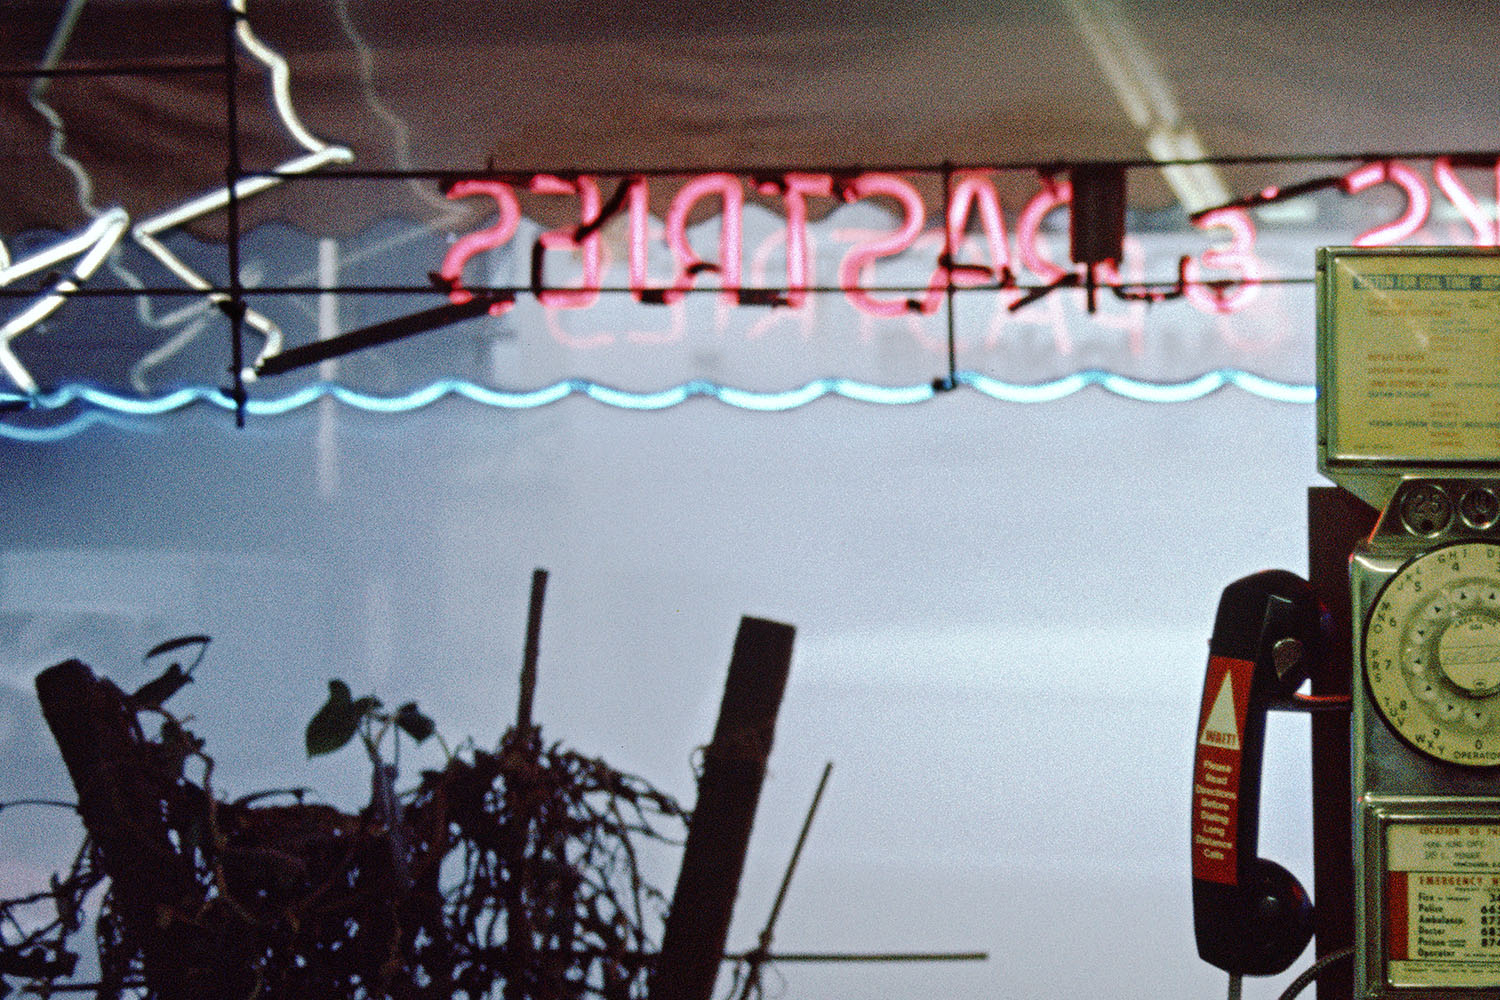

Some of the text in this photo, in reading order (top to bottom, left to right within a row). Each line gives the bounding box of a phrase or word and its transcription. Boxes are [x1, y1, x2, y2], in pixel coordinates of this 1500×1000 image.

[1413, 581, 1422, 592] 5
[1389, 617, 1397, 628] 6
[1196, 784, 1237, 800] Directions
[1201, 797, 1230, 812] Before
[1204, 825, 1225, 838] Long
[1203, 847, 1225, 861] Calls
[1419, 876, 1483, 886] EMERGENCY
[1418, 892, 1434, 901] Fire
[1418, 904, 1443, 913] Police
[1418, 915, 1464, 925] Ambulance
[1418, 926, 1445, 936] Doctor
[1418, 937, 1445, 947] Poison
[1418, 948, 1455, 958] Operator
